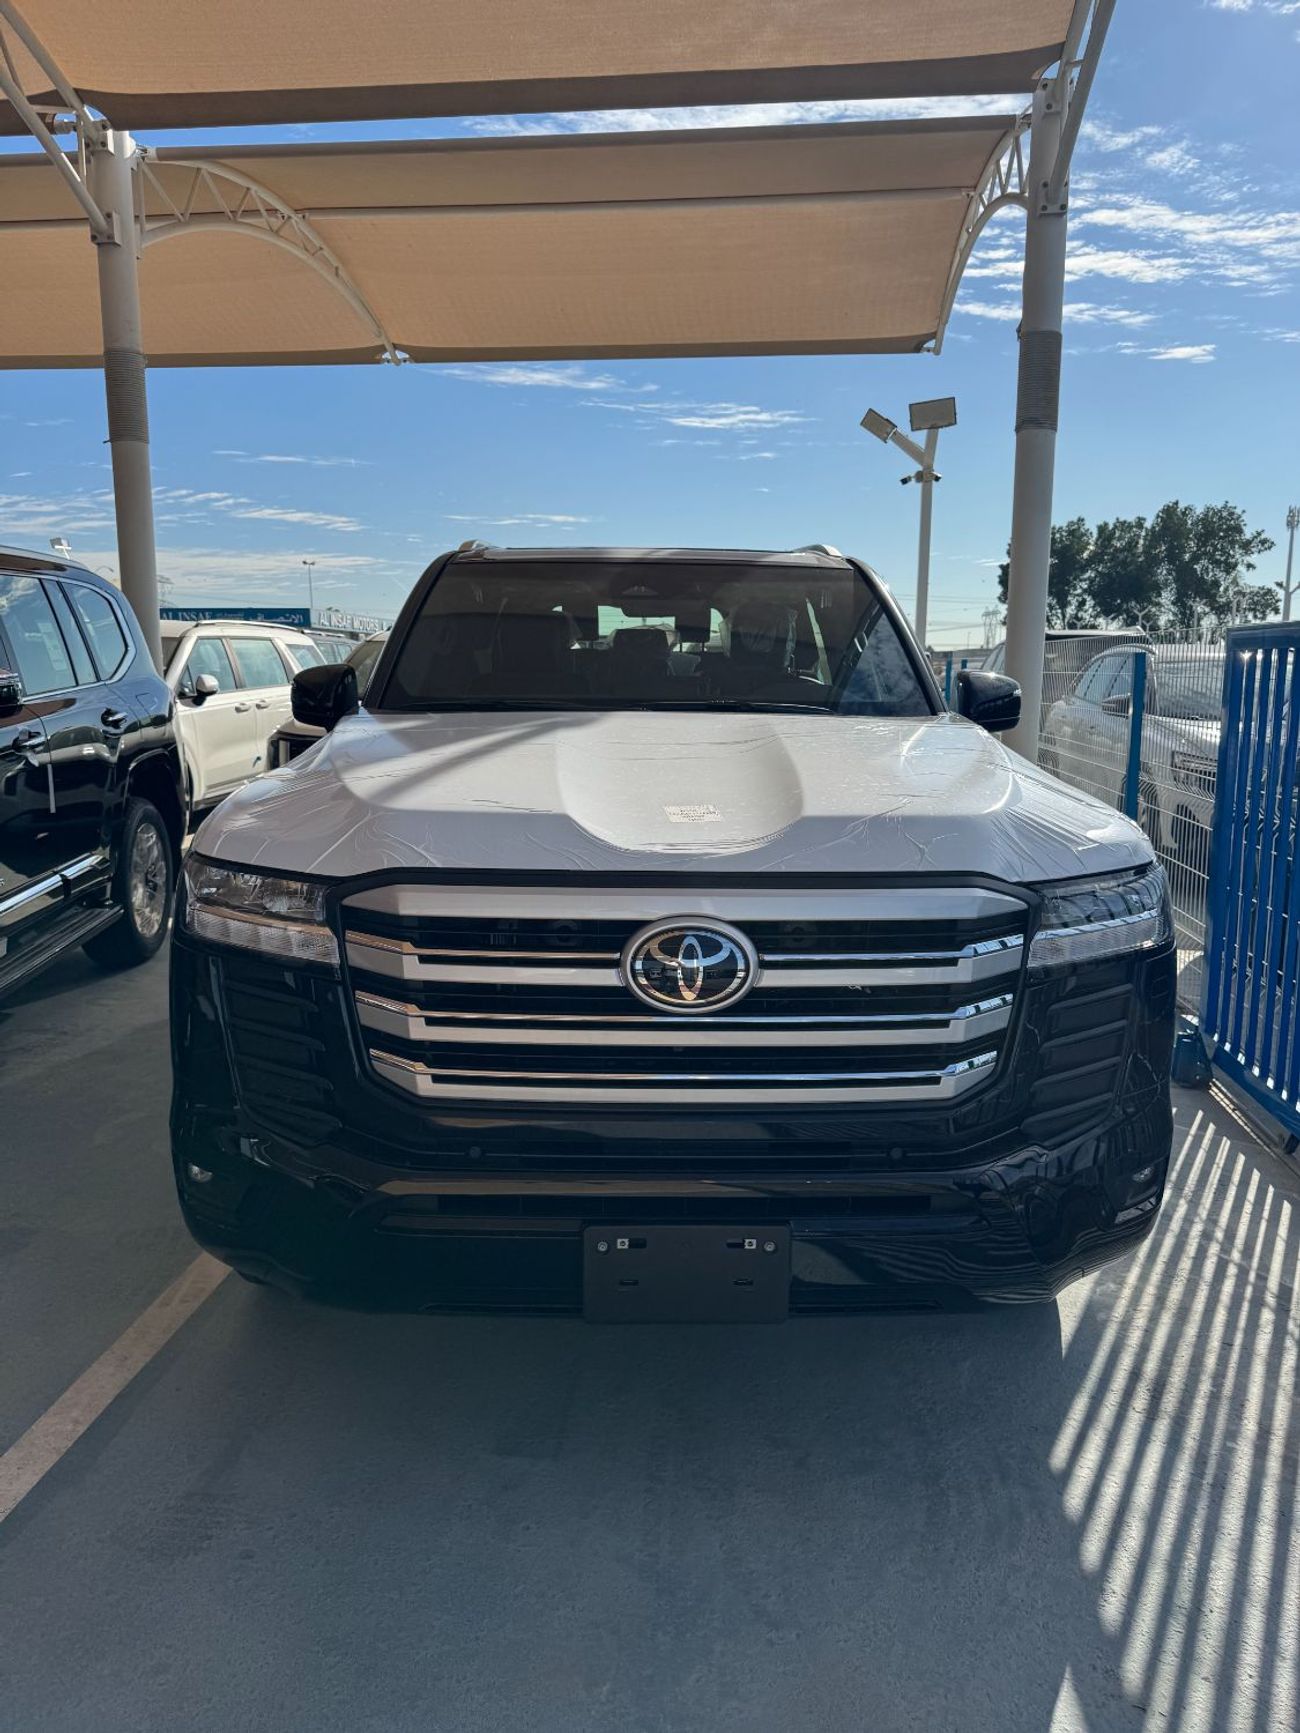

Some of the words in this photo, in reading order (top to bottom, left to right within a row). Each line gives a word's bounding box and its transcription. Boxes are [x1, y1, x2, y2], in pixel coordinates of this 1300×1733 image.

[320, 611, 330, 626] AL
[330, 612, 352, 628] INSAF
[353, 616, 379, 631] MOTORS
